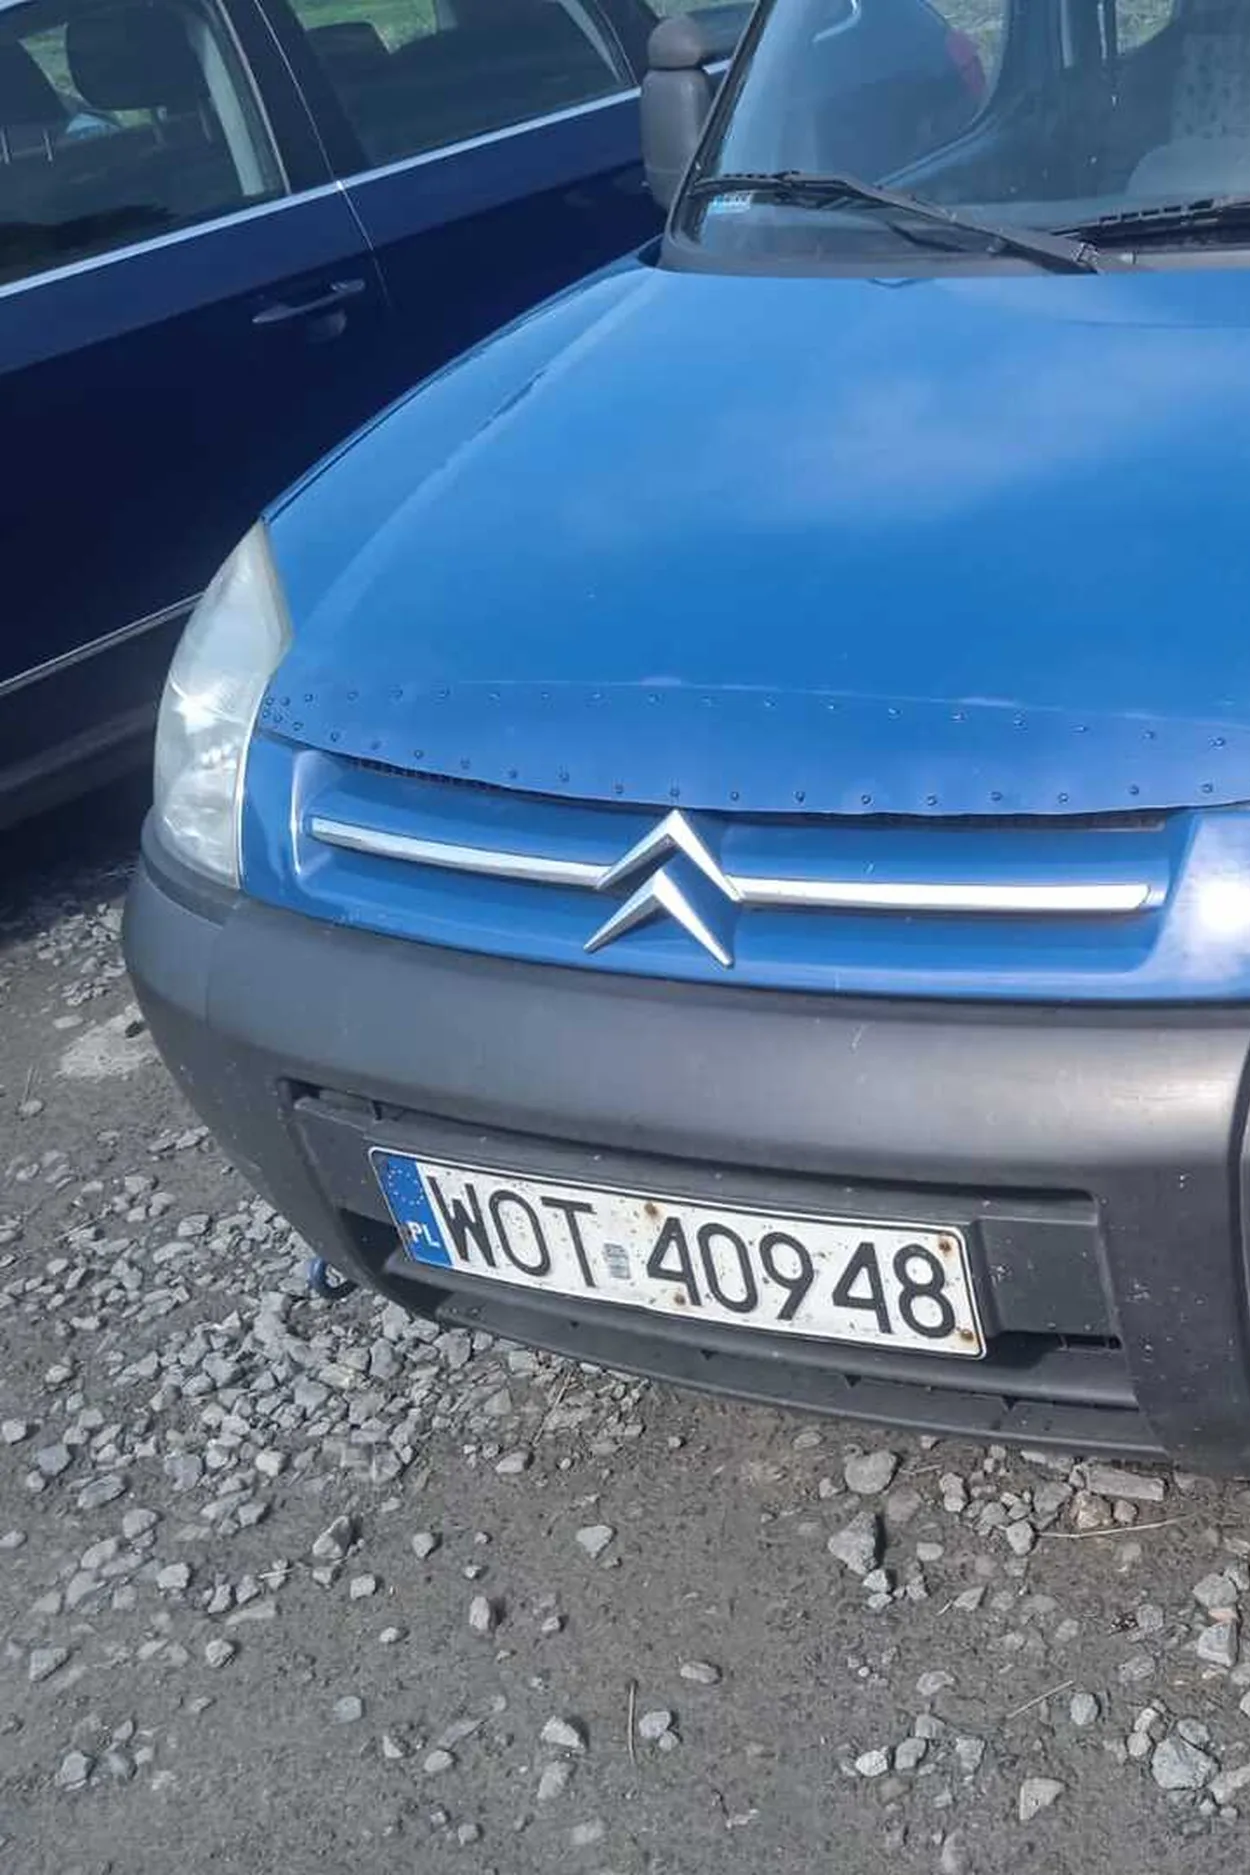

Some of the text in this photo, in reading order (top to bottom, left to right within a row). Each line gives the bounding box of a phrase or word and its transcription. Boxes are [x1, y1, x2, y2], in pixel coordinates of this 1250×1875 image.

[407, 1220, 441, 1248] PL
[426, 1175, 957, 1340] WOT 40948
